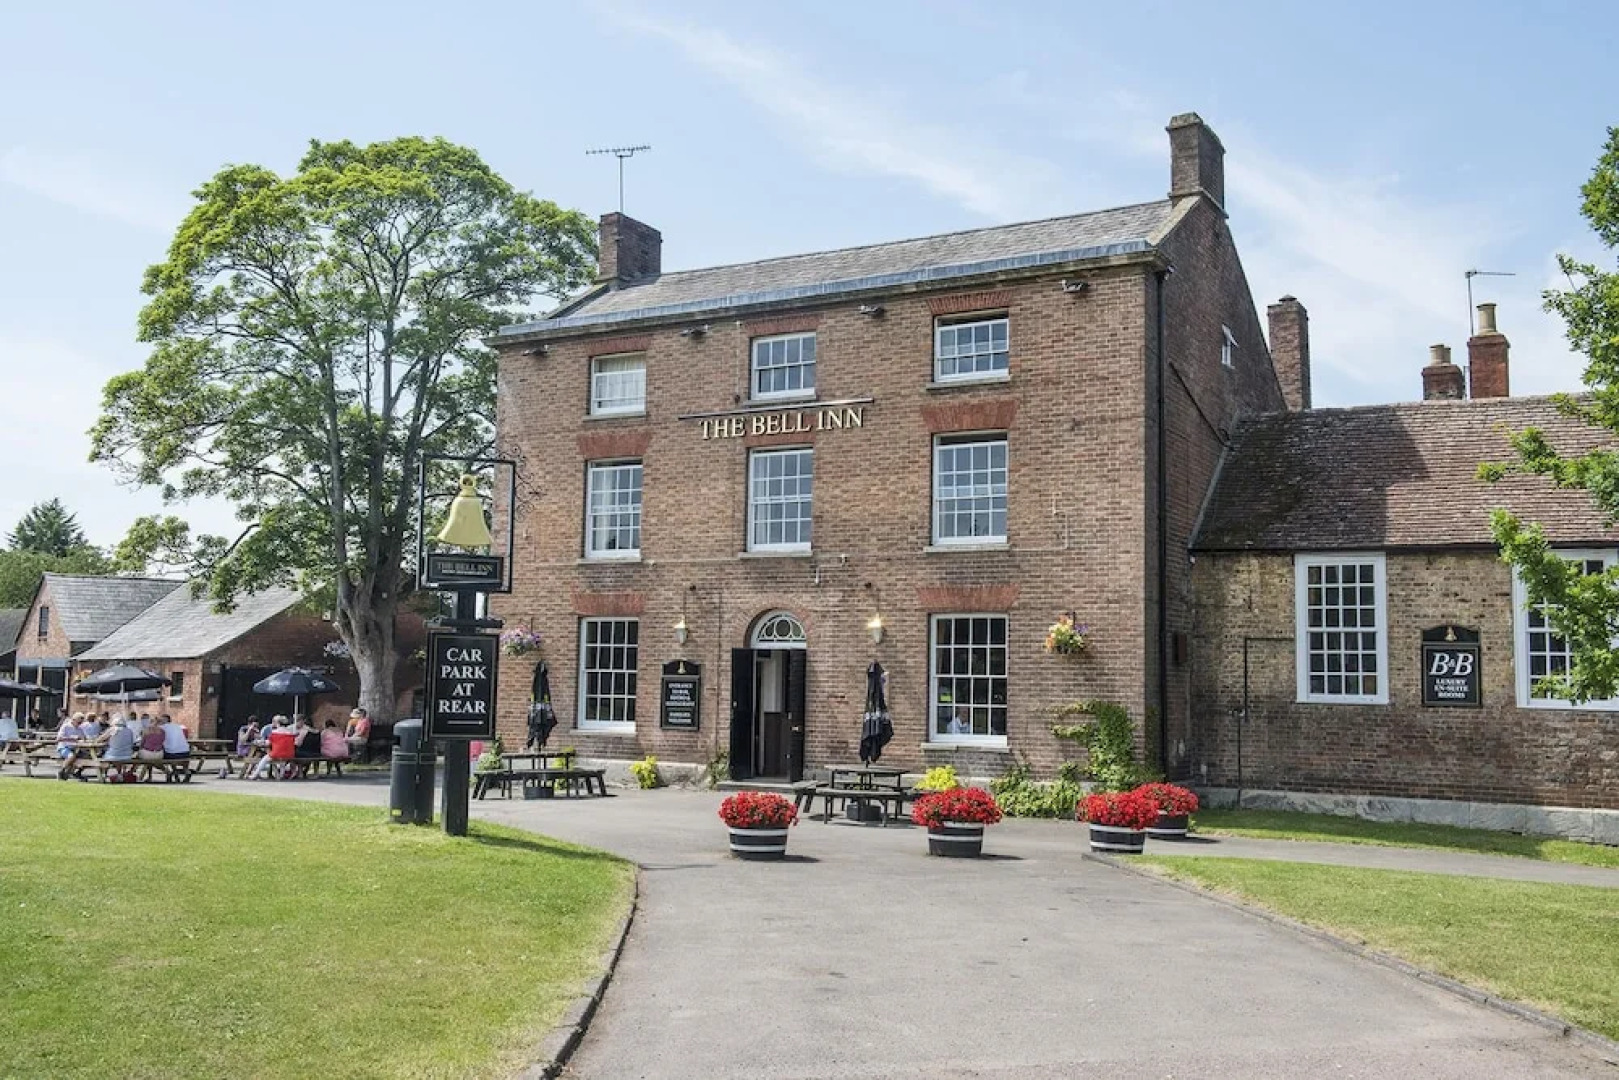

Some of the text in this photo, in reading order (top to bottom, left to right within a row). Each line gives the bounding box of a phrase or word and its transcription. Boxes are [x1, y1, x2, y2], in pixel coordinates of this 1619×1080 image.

[699, 407, 864, 440] THE BELL INN
[446, 647, 483, 662] CAR
[1429, 652, 1474, 676] B&B
[441, 665, 487, 679] PARK
[452, 682, 475, 696] AT
[438, 699, 487, 714] REAR
